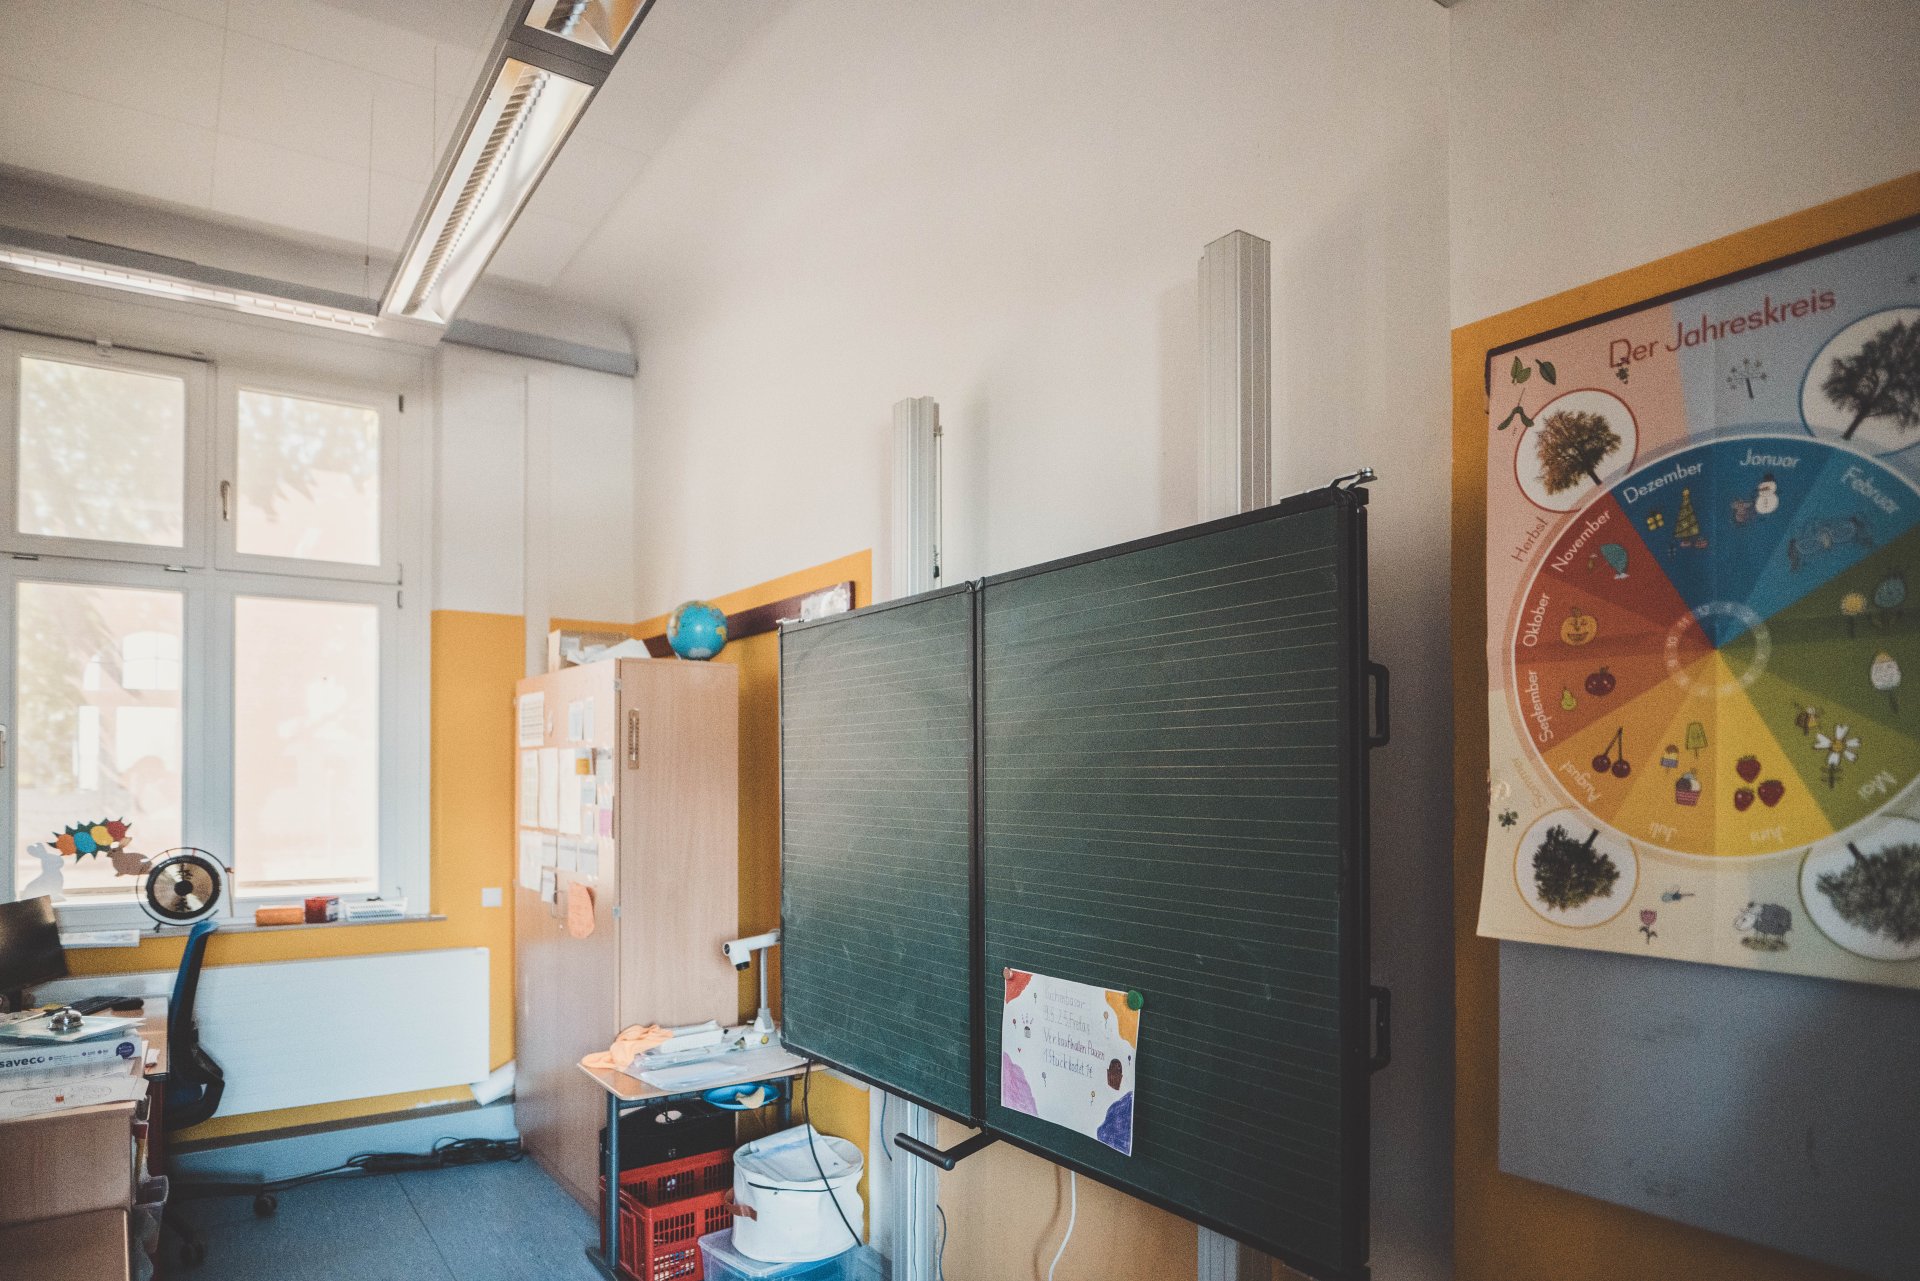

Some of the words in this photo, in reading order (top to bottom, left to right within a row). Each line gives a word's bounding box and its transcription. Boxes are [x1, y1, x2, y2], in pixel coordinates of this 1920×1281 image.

[1608, 337, 1659, 369] Der
[1666, 288, 1836, 353] Jahreskreis
[1740, 448, 1800, 468] Januar
[1622, 462, 1704, 504] Dezember
[1511, 516, 1548, 563] Herbst
[1551, 510, 1612, 573] November
[1522, 593, 1551, 647] Oktober
[1525, 670, 1554, 743] September
[1558, 760, 1602, 803] August
[0, 1056, 46, 1068] saveco
